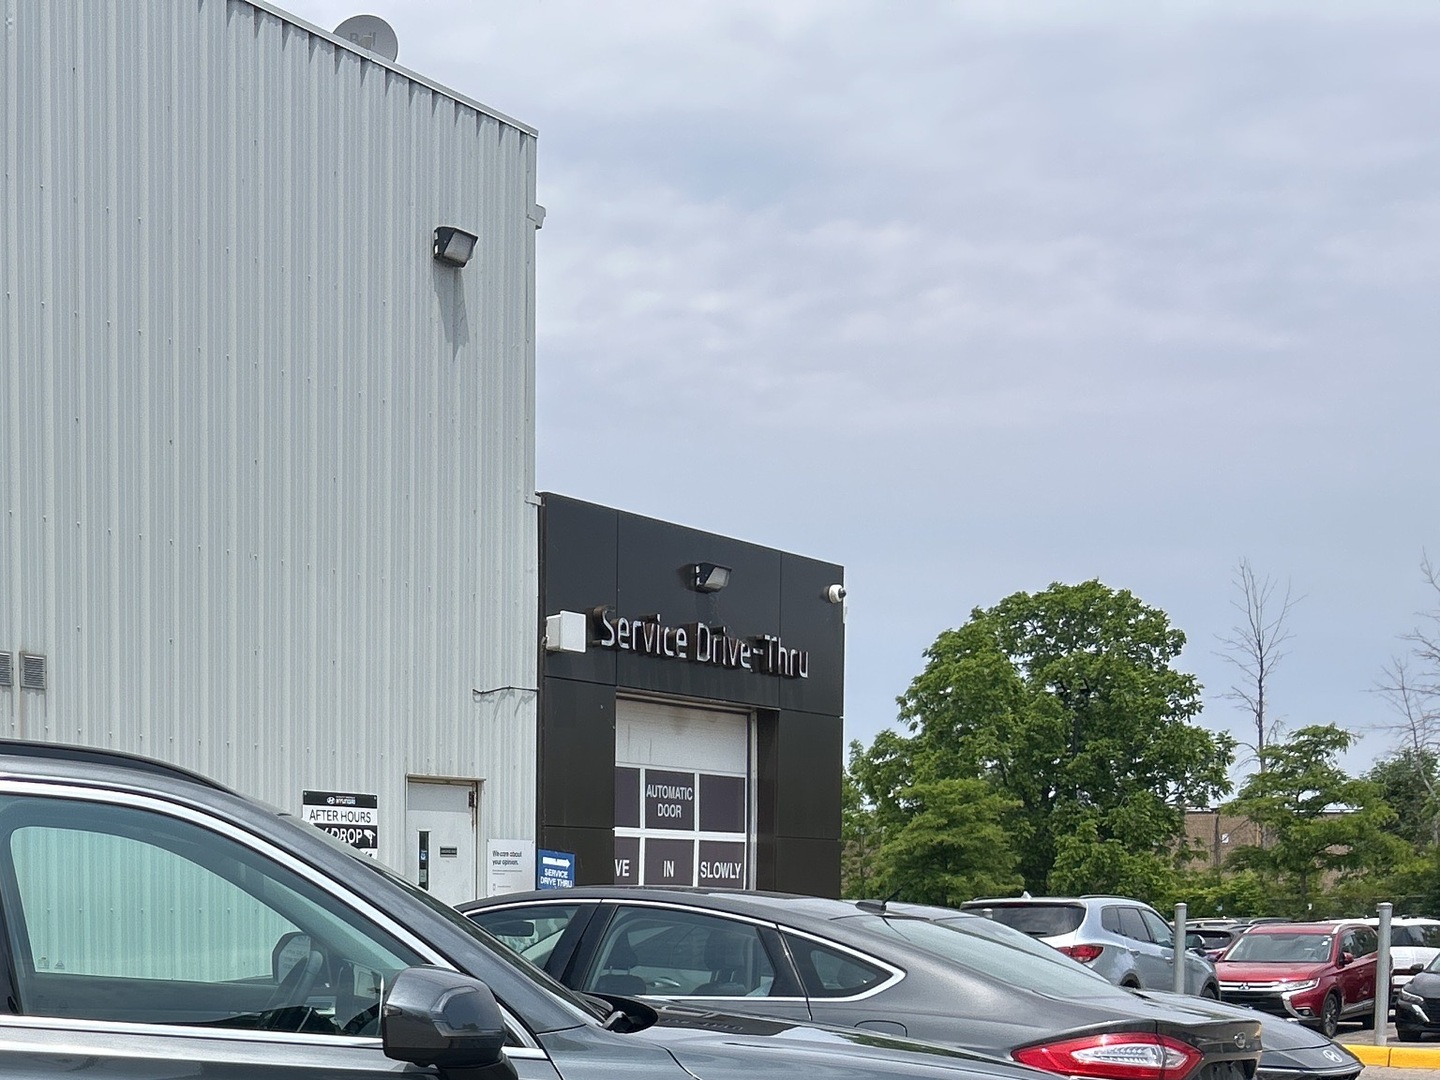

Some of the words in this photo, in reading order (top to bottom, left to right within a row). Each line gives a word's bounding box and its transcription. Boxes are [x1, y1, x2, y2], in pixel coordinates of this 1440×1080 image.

[600, 606, 687, 659] Service
[696, 622, 809, 678] Drive-Thru
[646, 784, 693, 800] AUTOMATIC
[309, 809, 339, 821] AFTER
[341, 811, 371, 823] HOURS
[657, 803, 682, 818] DOOR
[330, 827, 362, 844] DROP
[544, 868, 568, 878] SERVICE
[663, 860, 675, 877] IN
[700, 861, 742, 879] SLOWLY
[540, 876, 556, 886] DRIVE
[557, 877, 572, 888] THRU
